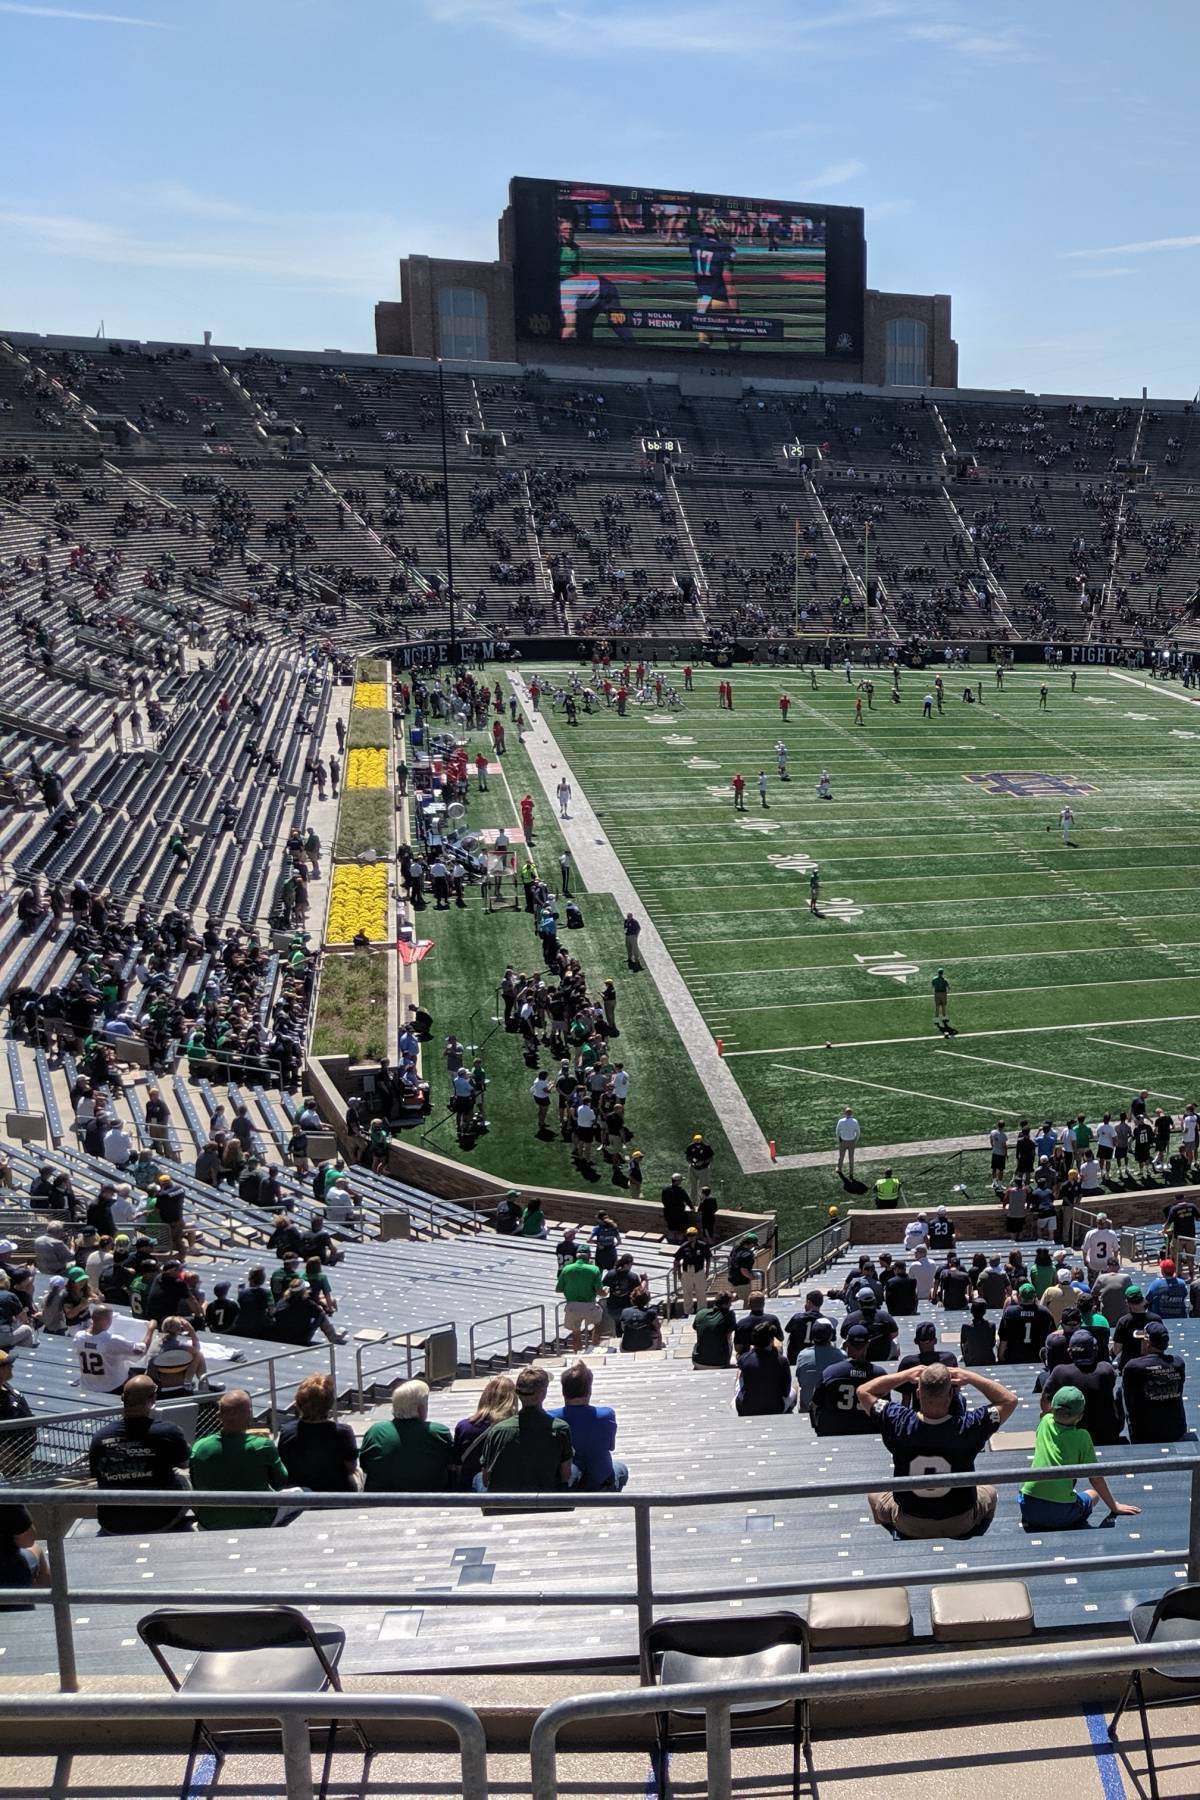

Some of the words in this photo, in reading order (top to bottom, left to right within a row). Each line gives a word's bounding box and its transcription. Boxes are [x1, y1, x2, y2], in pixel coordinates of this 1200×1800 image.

[648, 319, 681, 329] HENRY
[791, 446, 803, 456] 25
[767, 853, 818, 869] 30
[853, 950, 919, 976] 10
[934, 1222, 948, 1236] 23
[1096, 1241, 1107, 1259] 3
[215, 1308, 225, 1326] 7
[1024, 1322, 1032, 1344] 1
[80, 1351, 105, 1376] 12
[850, 1369, 867, 1378] IRISH
